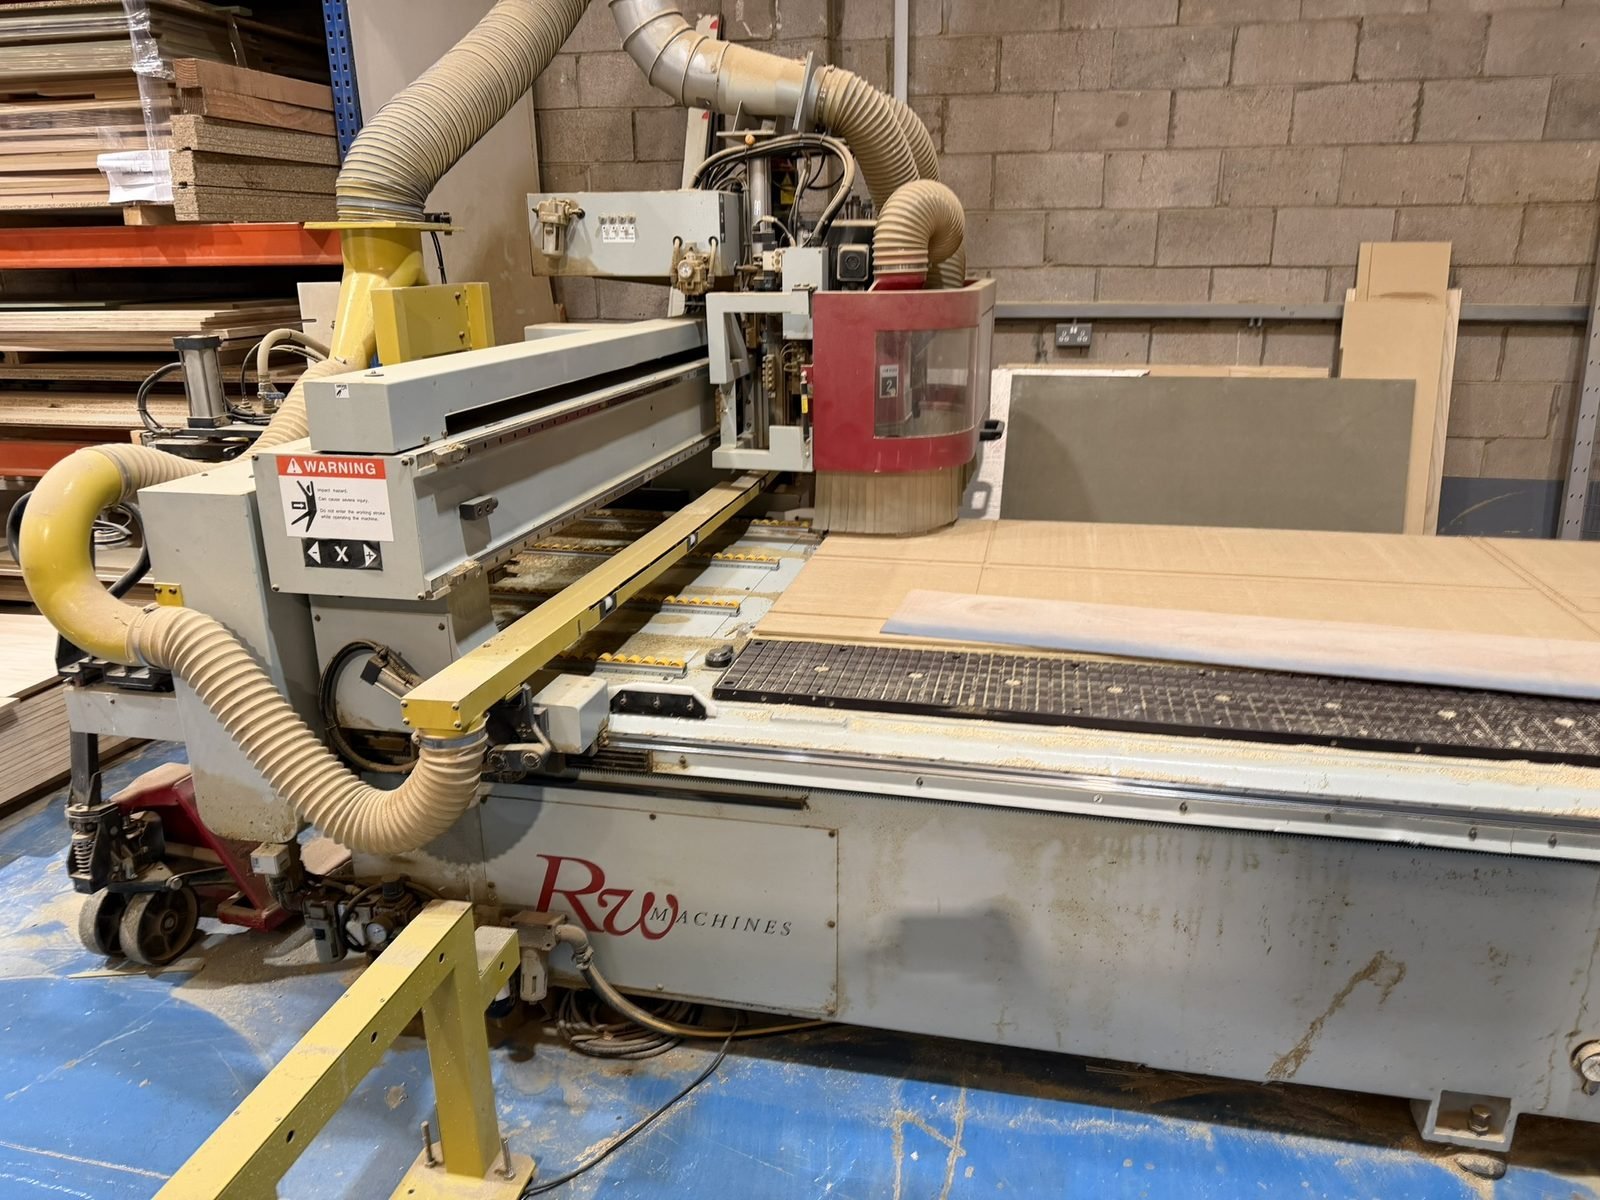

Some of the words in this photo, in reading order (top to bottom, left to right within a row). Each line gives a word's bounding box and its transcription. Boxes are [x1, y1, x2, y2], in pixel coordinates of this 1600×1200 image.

[304, 460, 376, 475] WARNING
[334, 546, 349, 562] X
[650, 907, 793, 937] MACHINES
